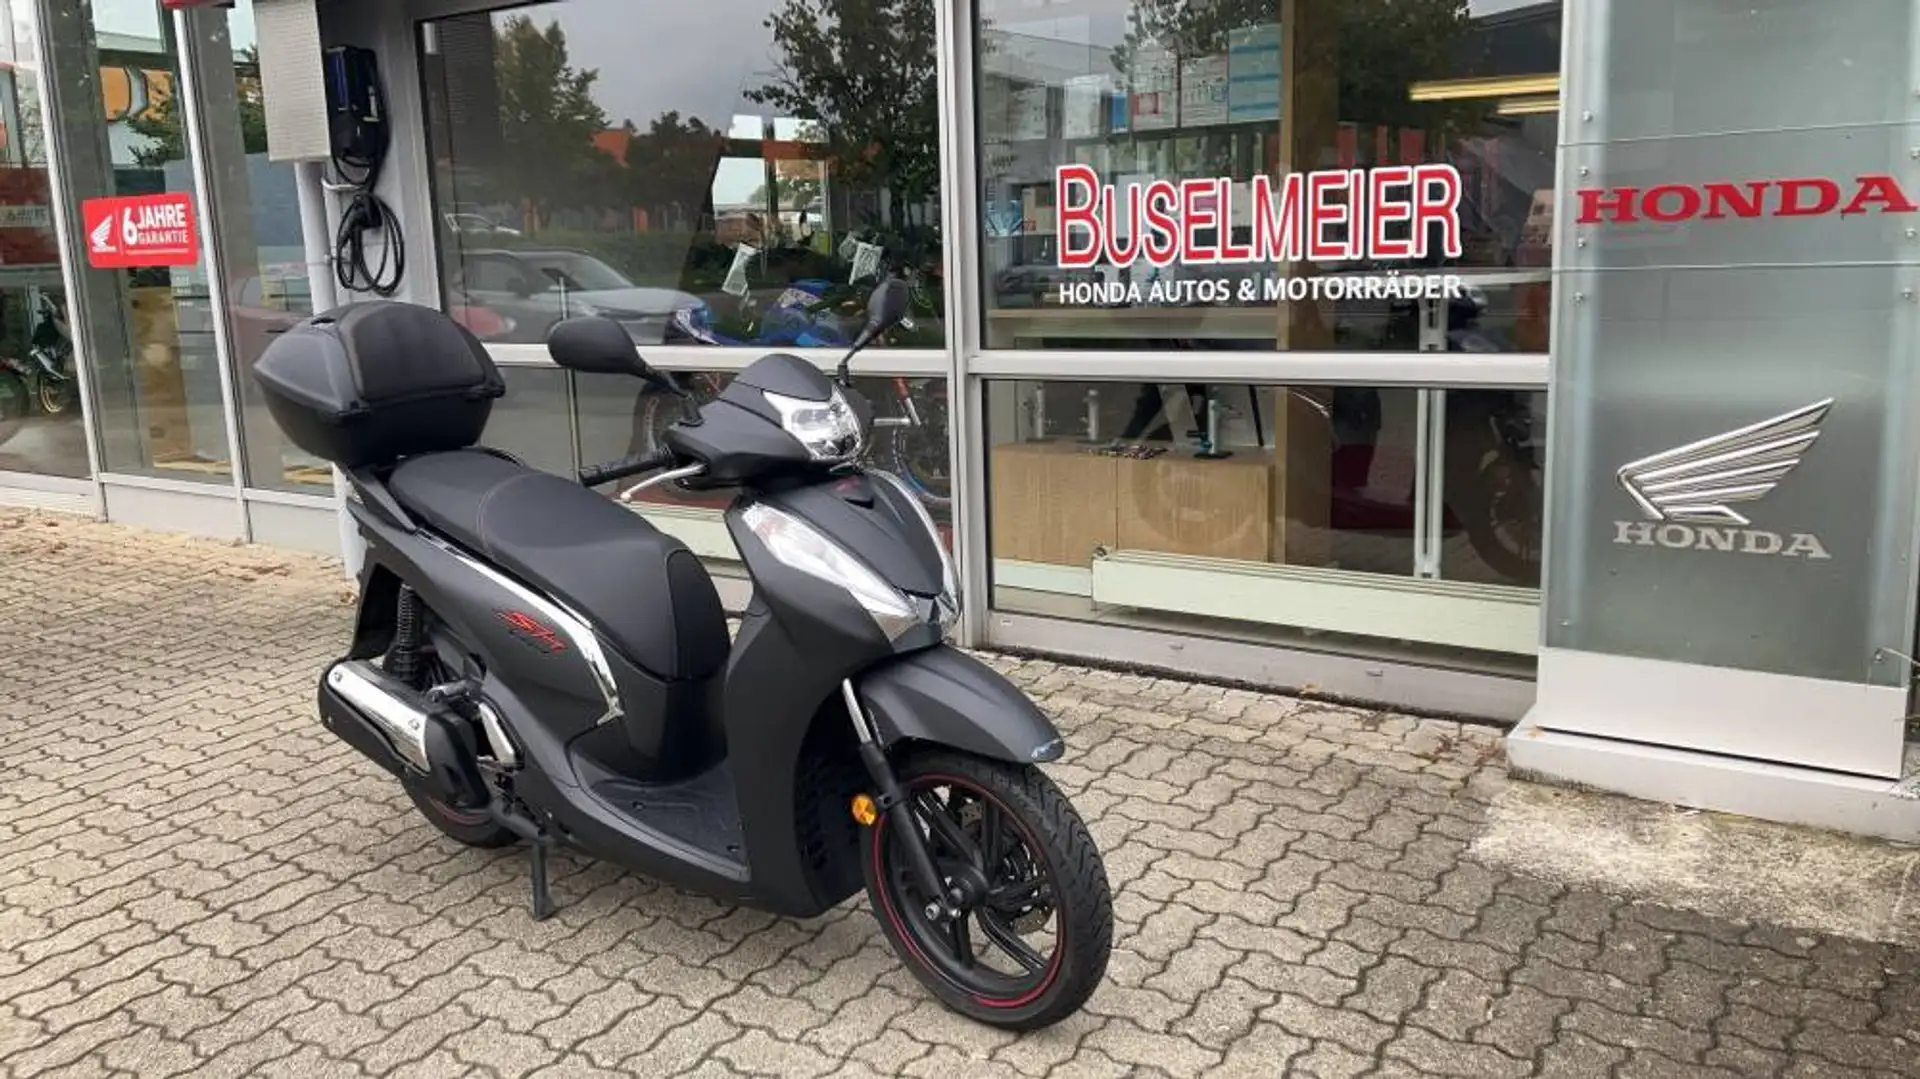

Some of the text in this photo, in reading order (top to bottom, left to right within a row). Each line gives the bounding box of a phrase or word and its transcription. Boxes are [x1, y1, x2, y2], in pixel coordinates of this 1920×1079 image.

[1576, 175, 1917, 223] HONDA
[122, 203, 187, 245] 6 JAHRE
[138, 229, 189, 245] GARANTIE
[1059, 270, 1462, 303] HONDA AUTOS & MOTORRÄDER
[1612, 520, 1832, 559] HONDA
